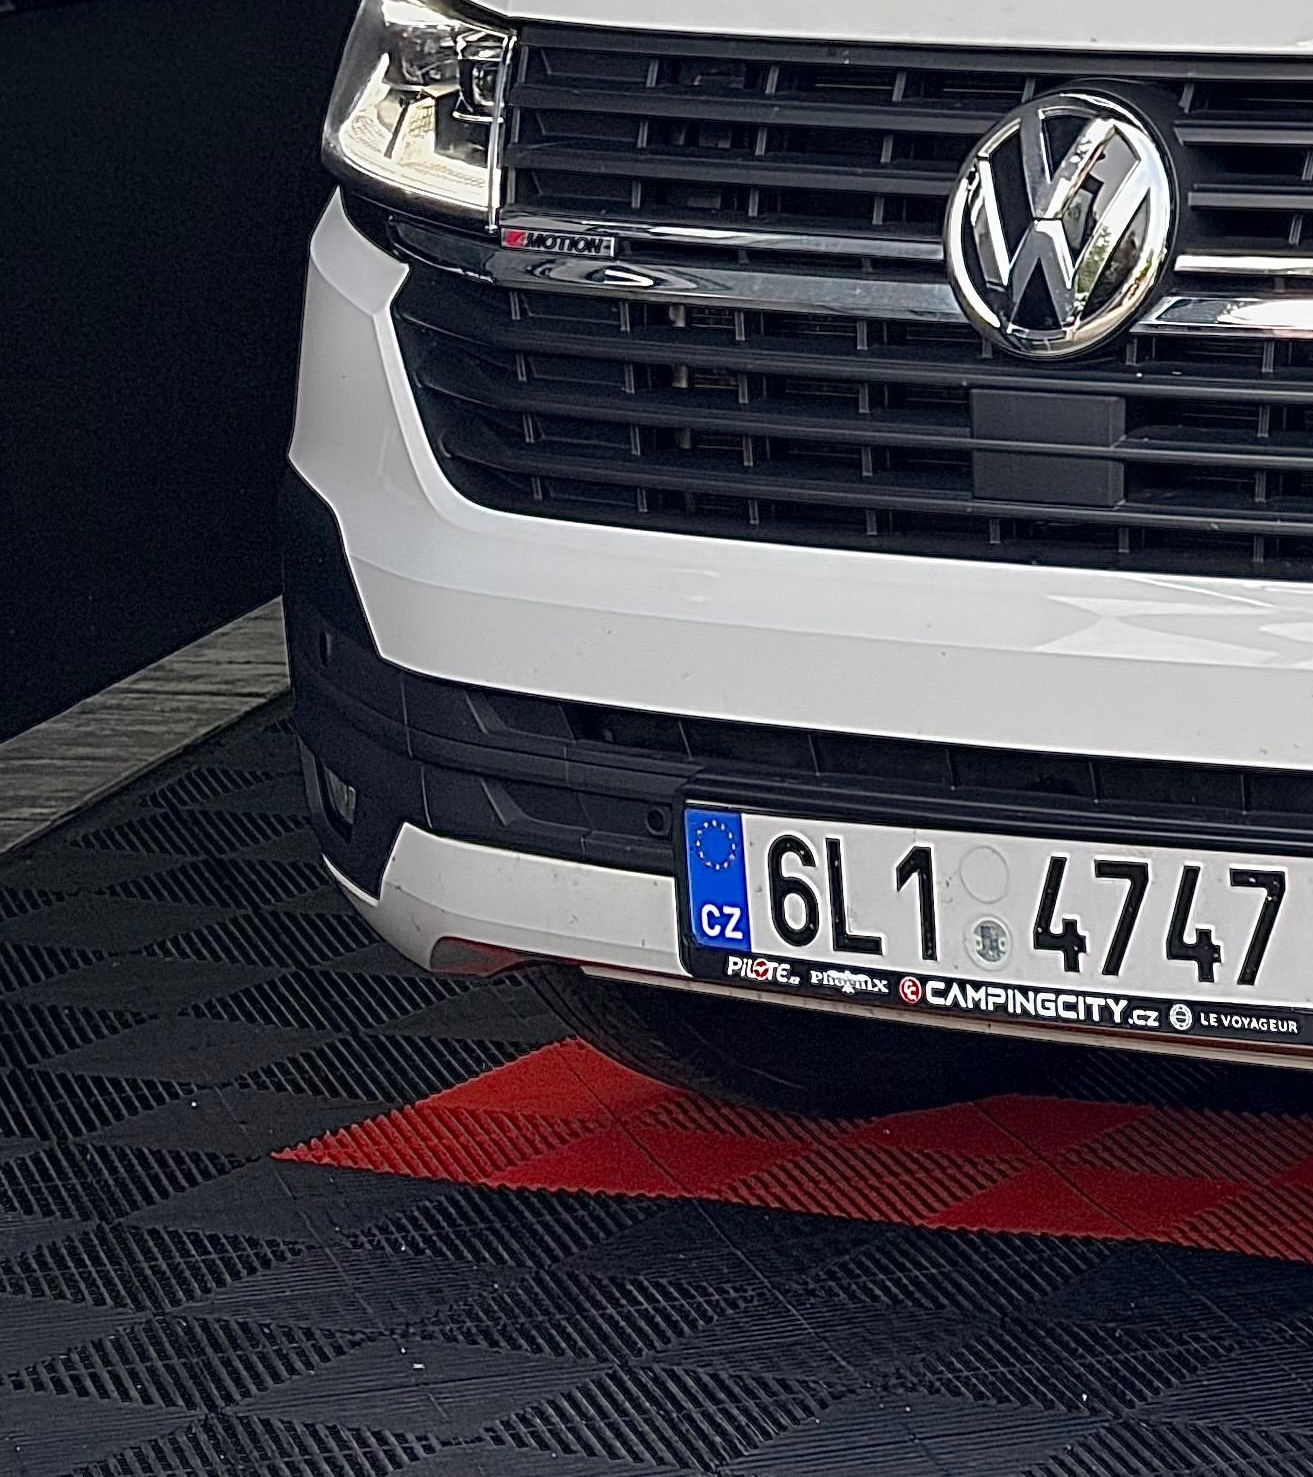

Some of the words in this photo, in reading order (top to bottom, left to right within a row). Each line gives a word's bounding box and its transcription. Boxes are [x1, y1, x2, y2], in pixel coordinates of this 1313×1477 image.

[701, 903, 744, 940] CZ
[767, 833, 938, 961] 6L1
[1032, 855, 1286, 986] 4747
[1200, 1012, 1218, 1023] LE
[1220, 1014, 1298, 1034] VOYAGEUR
